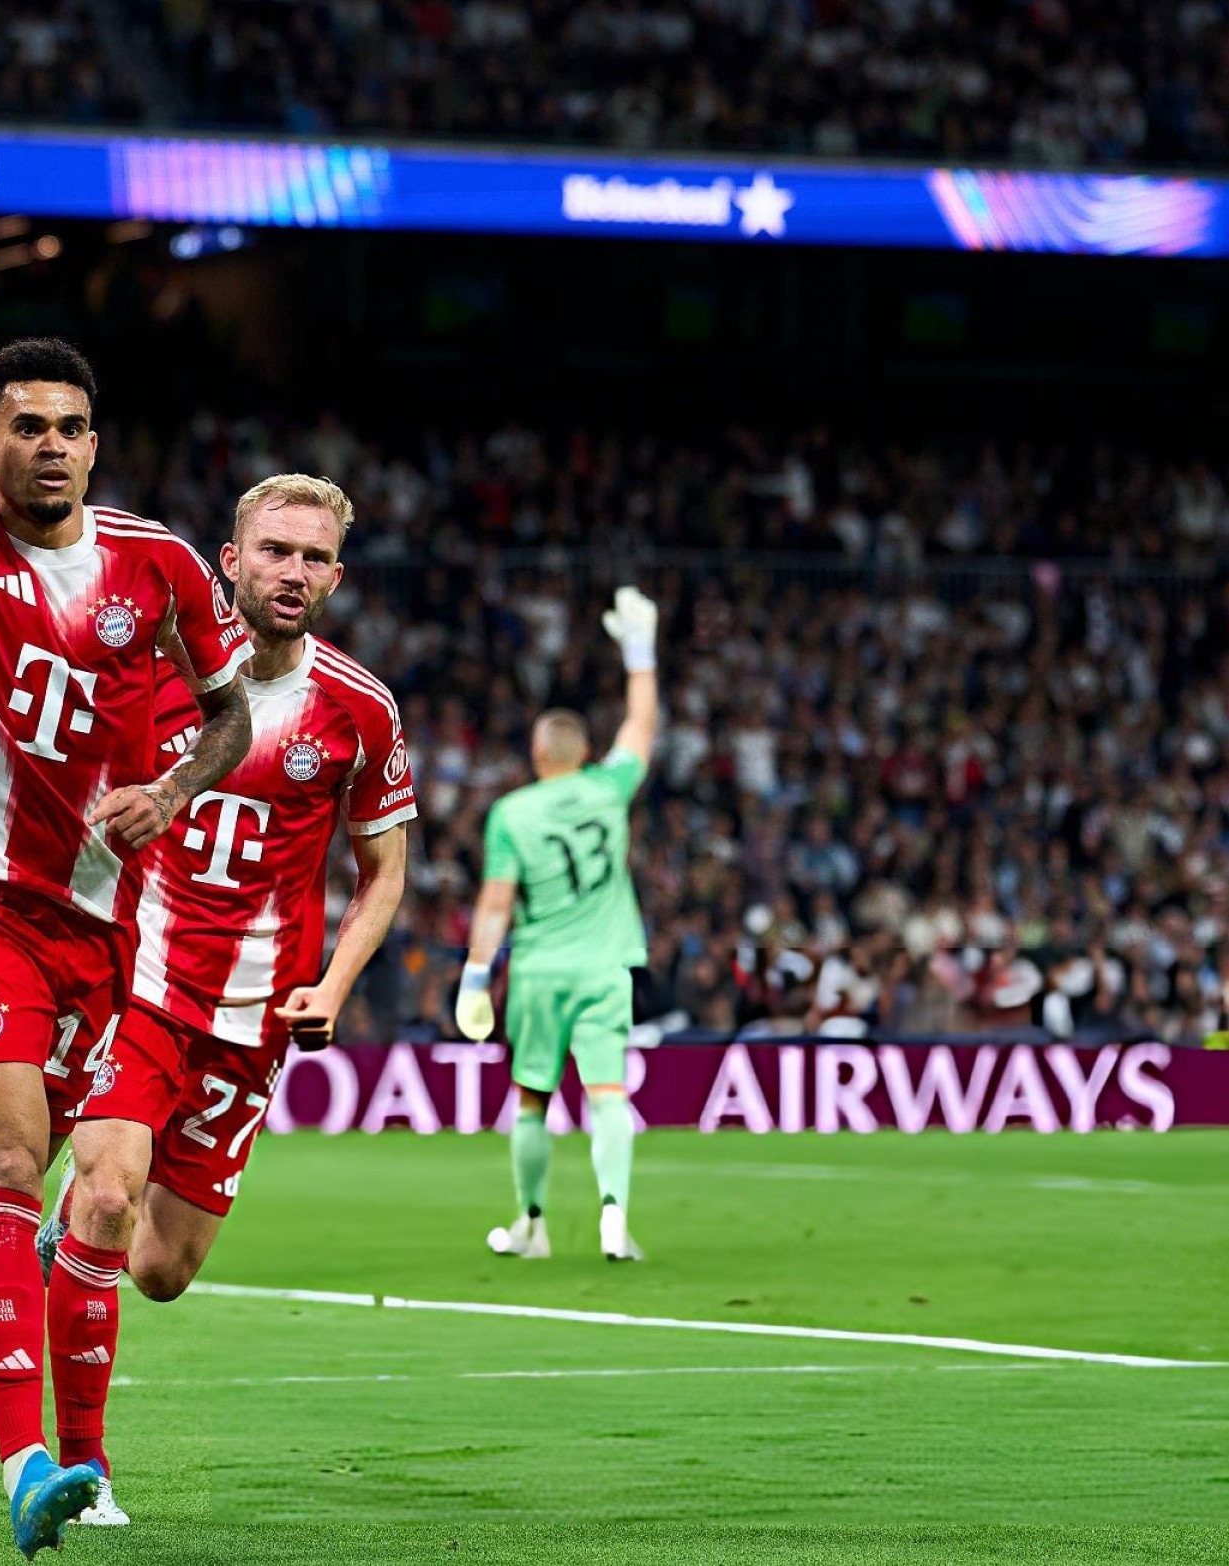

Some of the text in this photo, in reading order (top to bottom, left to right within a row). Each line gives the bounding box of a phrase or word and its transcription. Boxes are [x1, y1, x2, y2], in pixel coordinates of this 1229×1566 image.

[219, 623, 245, 652] Allia
[543, 818, 613, 897] 13
[43, 1010, 121, 1079] 14
[181, 1073, 269, 1159] 27
[699, 1043, 1175, 1134] AIRWAYS
